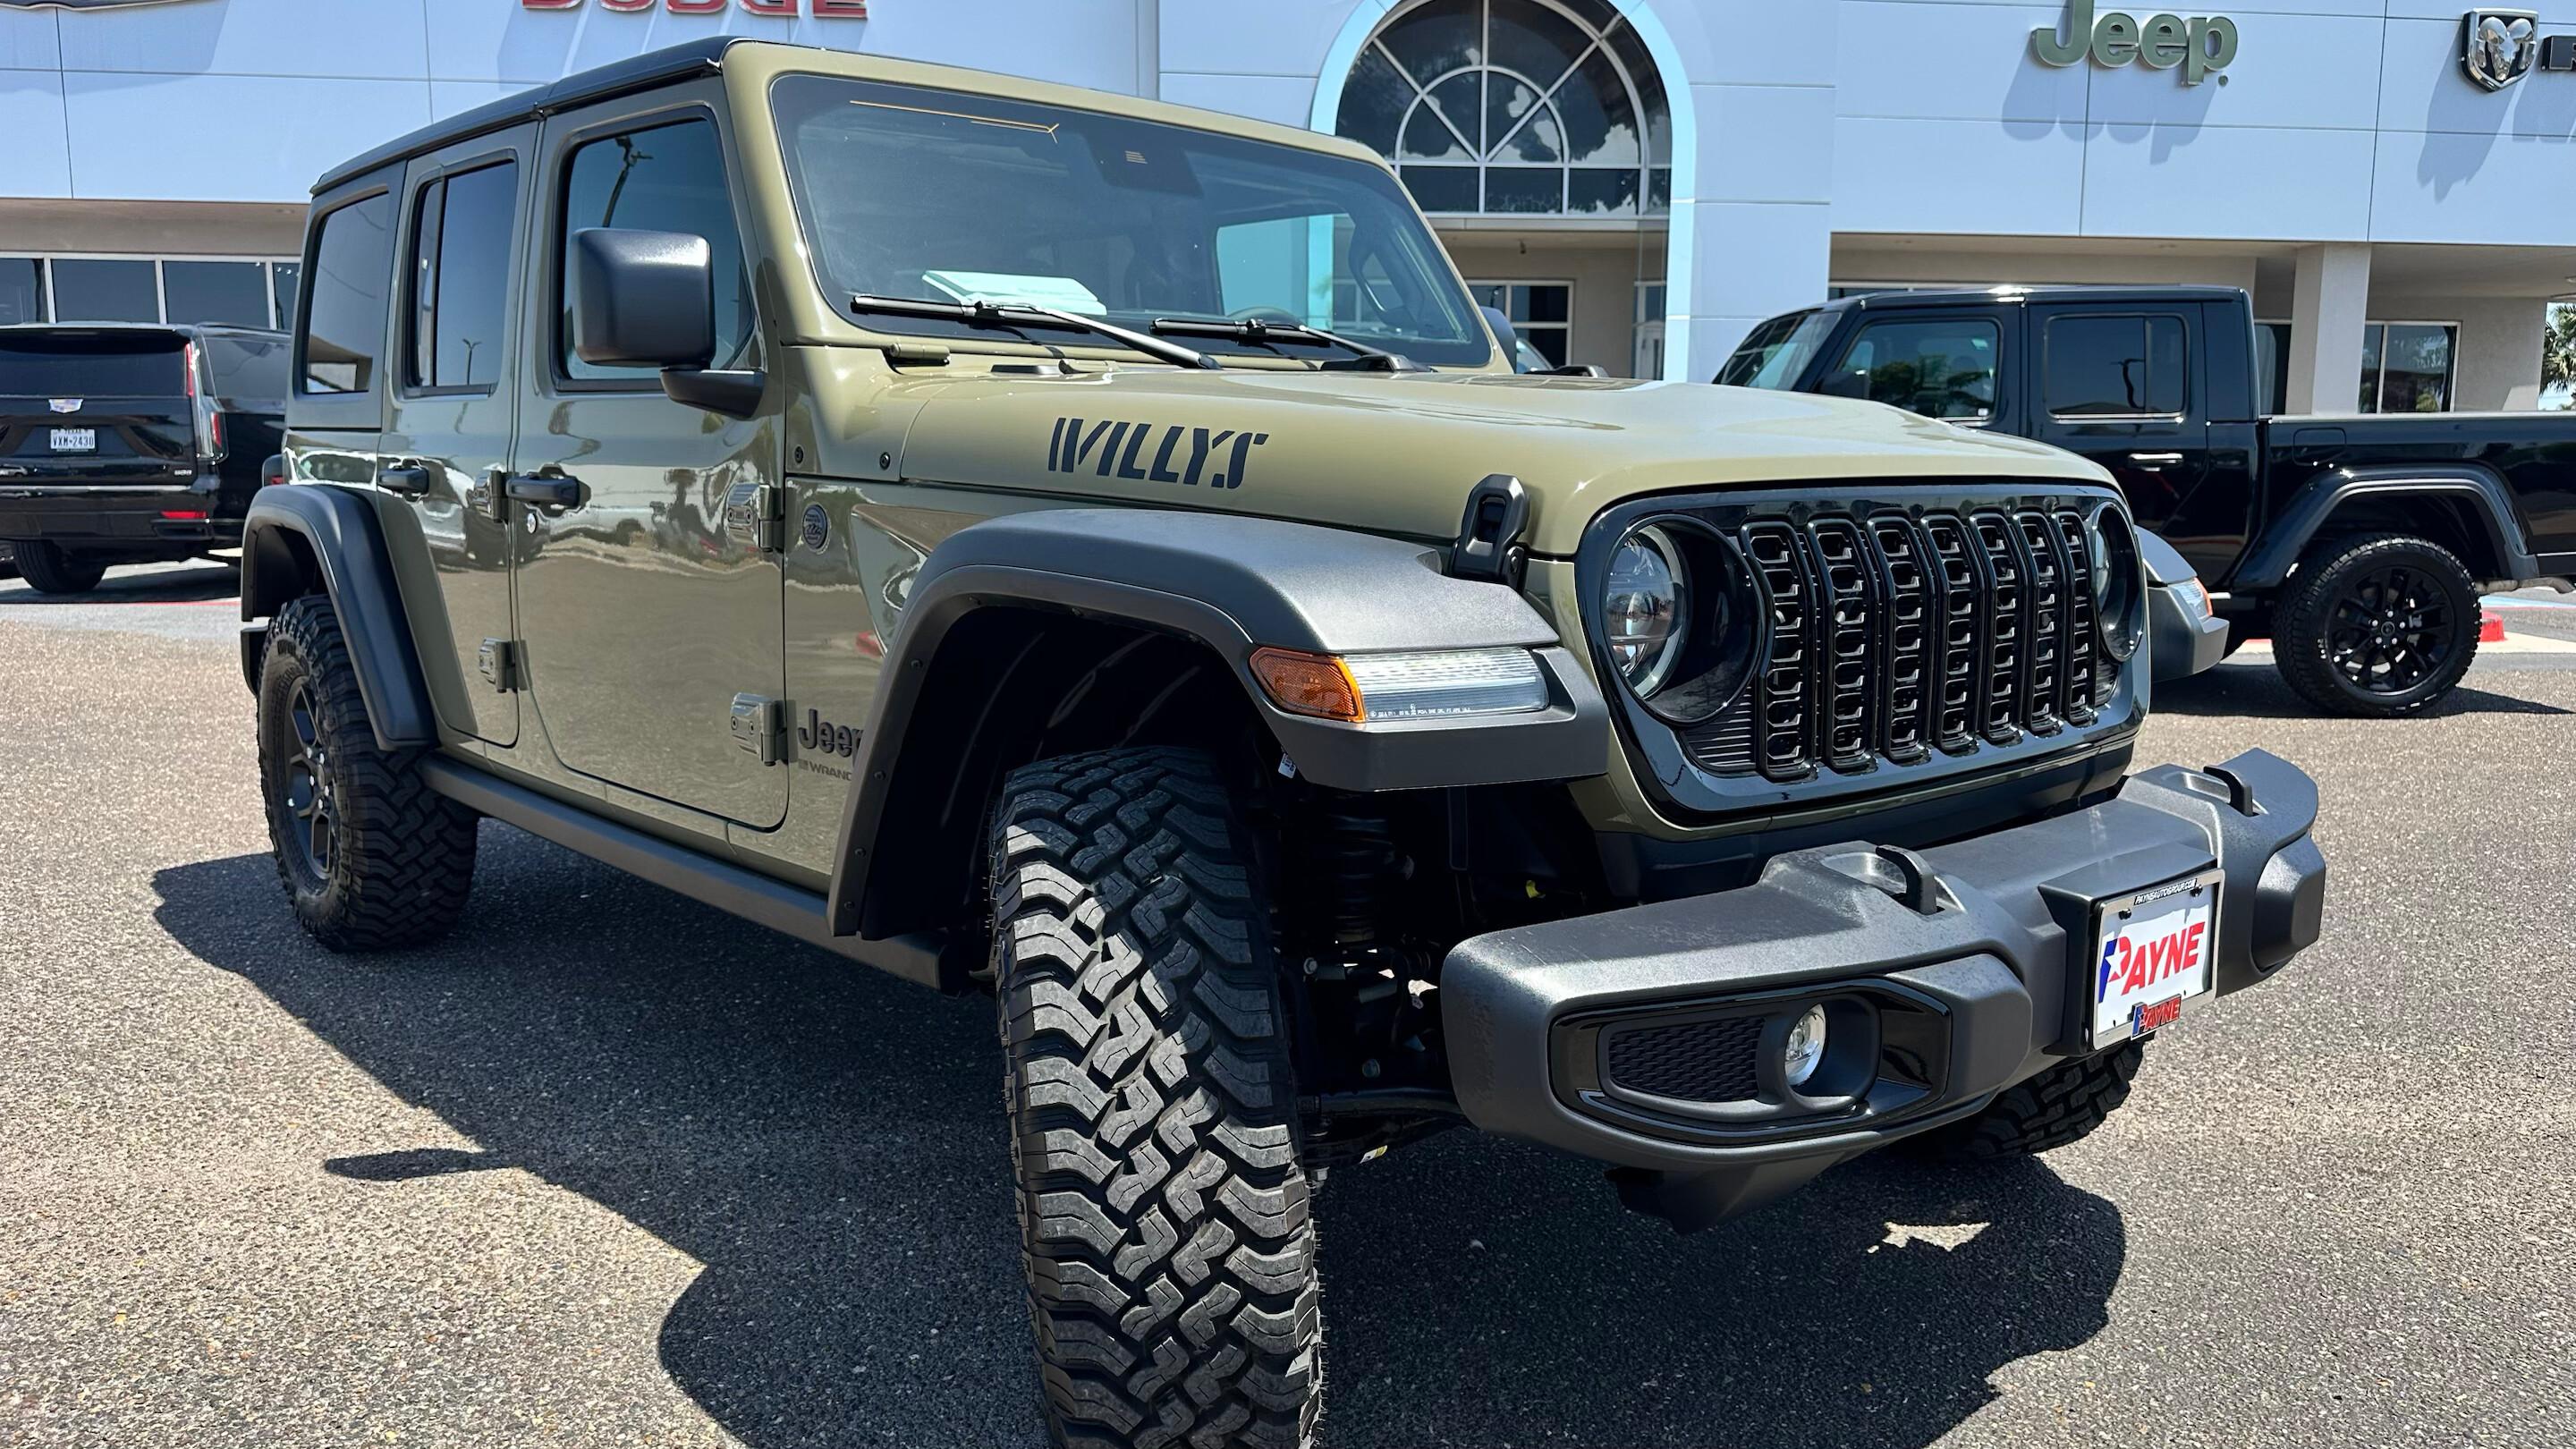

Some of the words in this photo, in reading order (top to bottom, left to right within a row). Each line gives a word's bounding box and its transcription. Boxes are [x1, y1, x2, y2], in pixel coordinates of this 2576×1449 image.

[2030, 0, 2237, 87] Jeep
[1048, 417, 1269, 489] WILLYS
[2098, 921, 2205, 1003] PAYNE
[2132, 996, 2181, 1037] PAYNE
